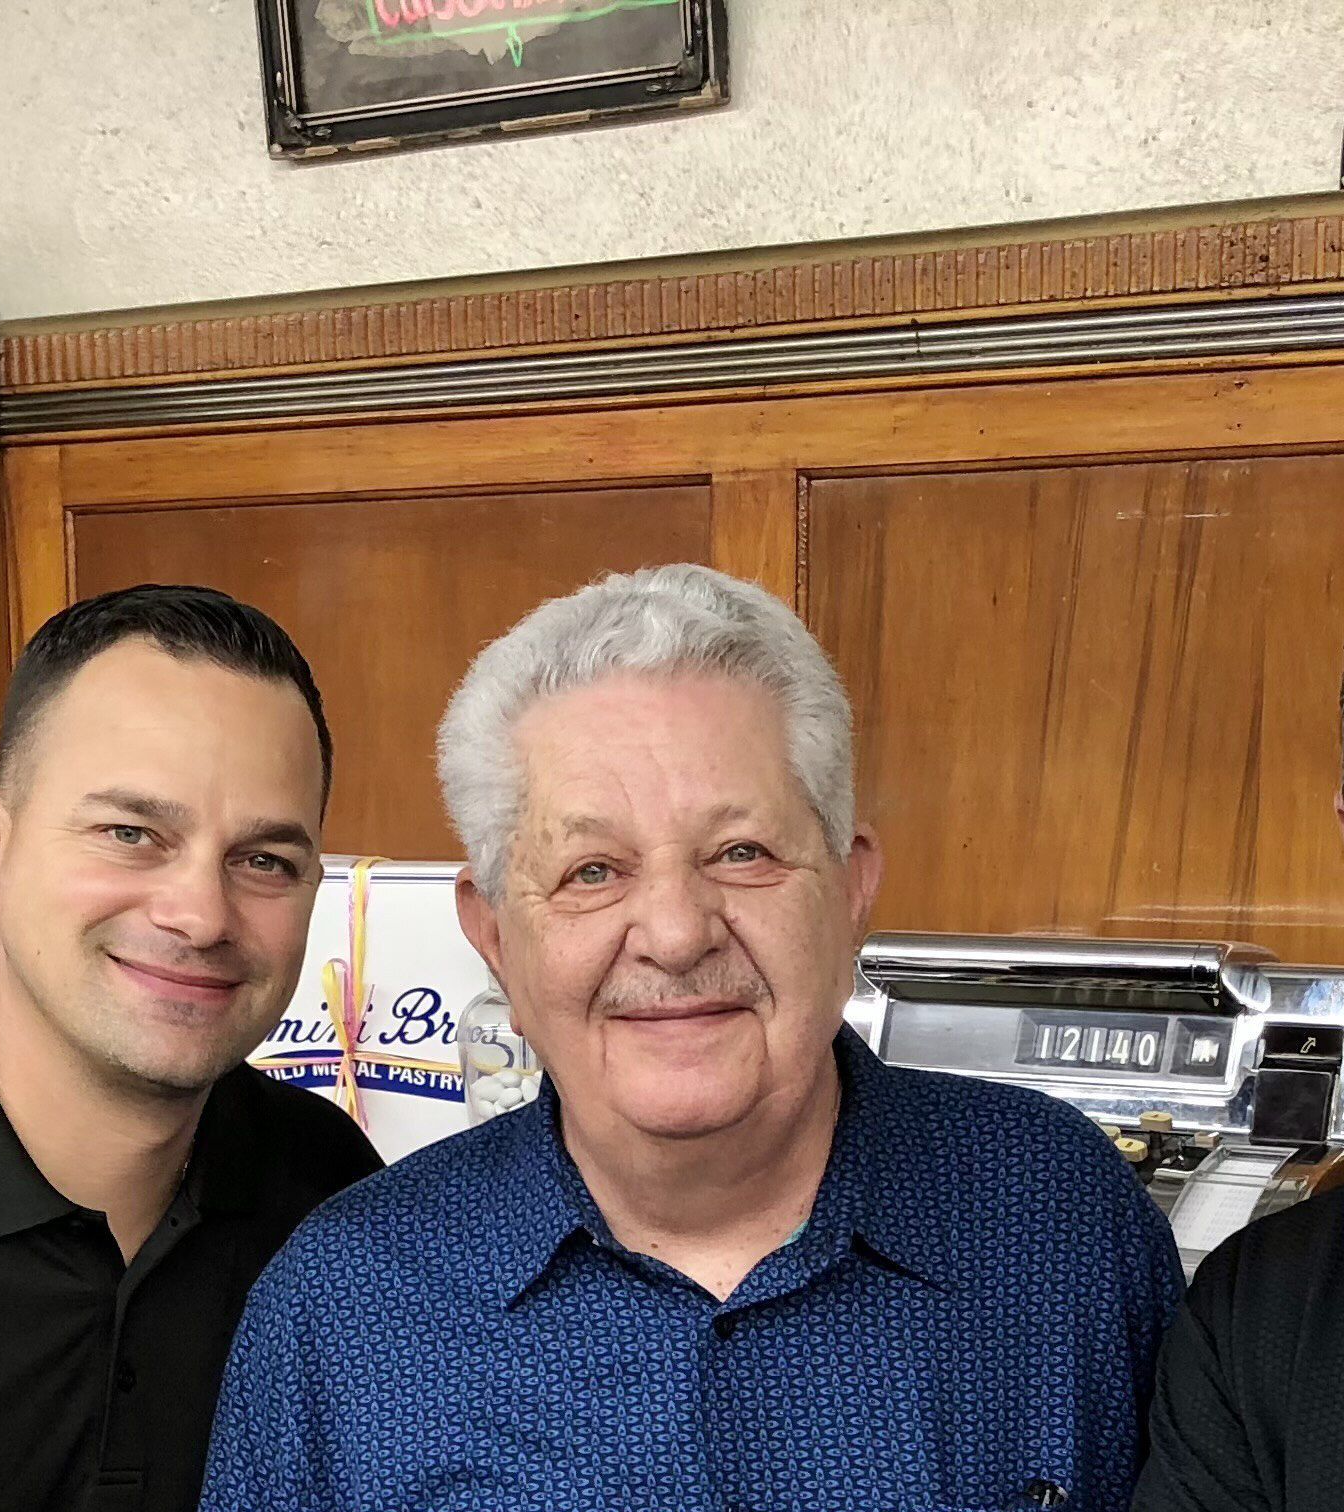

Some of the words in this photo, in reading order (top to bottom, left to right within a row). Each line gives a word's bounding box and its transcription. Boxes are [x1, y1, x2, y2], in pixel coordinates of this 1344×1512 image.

[266, 1064, 306, 1082] OLD
[311, 1061, 383, 1081] MEAL
[388, 1066, 464, 1091] PASTRY
